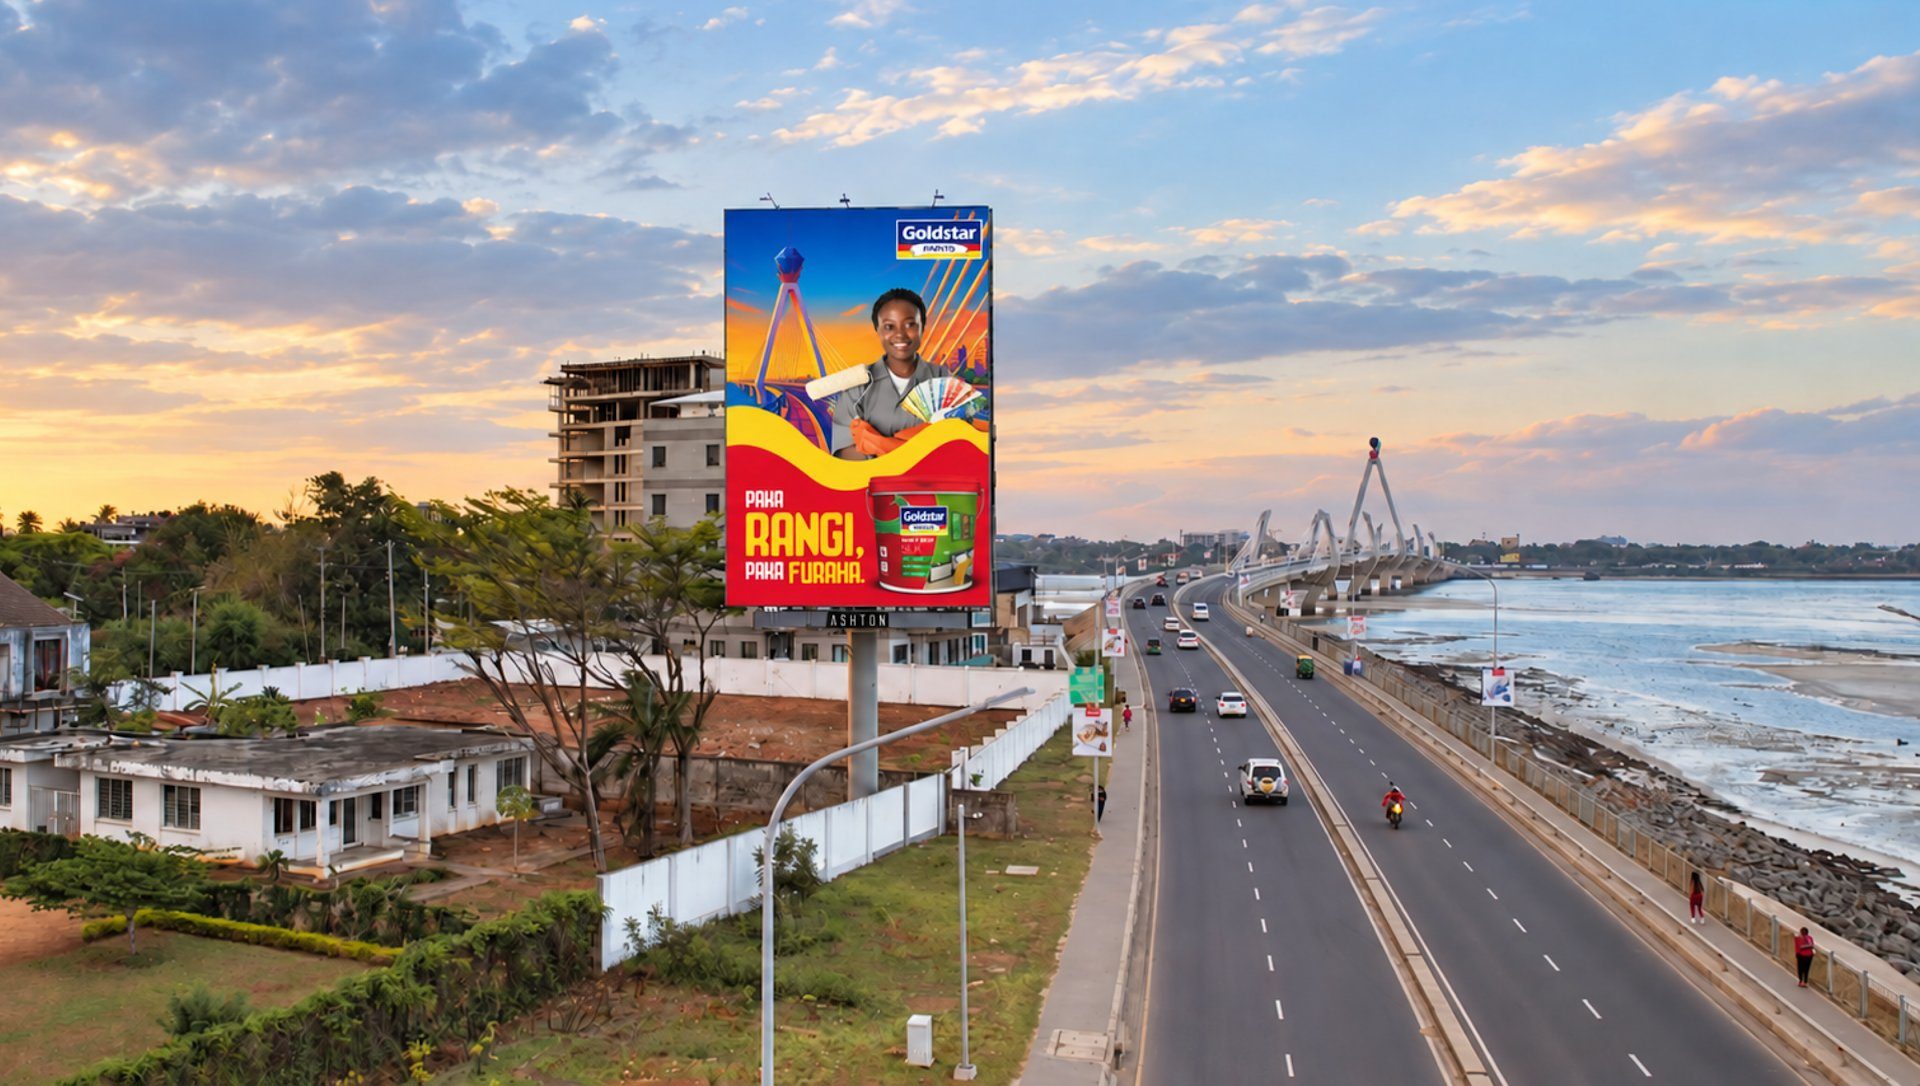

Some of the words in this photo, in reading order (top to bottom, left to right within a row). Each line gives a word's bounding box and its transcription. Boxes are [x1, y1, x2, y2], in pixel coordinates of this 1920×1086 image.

[902, 225, 977, 240] Goldstar
[745, 490, 784, 508] PAKA
[745, 512, 864, 559] RANGI,
[745, 561, 784, 580] PAKA
[788, 561, 865, 584] FURAHA.
[830, 614, 886, 627] ASHTON
